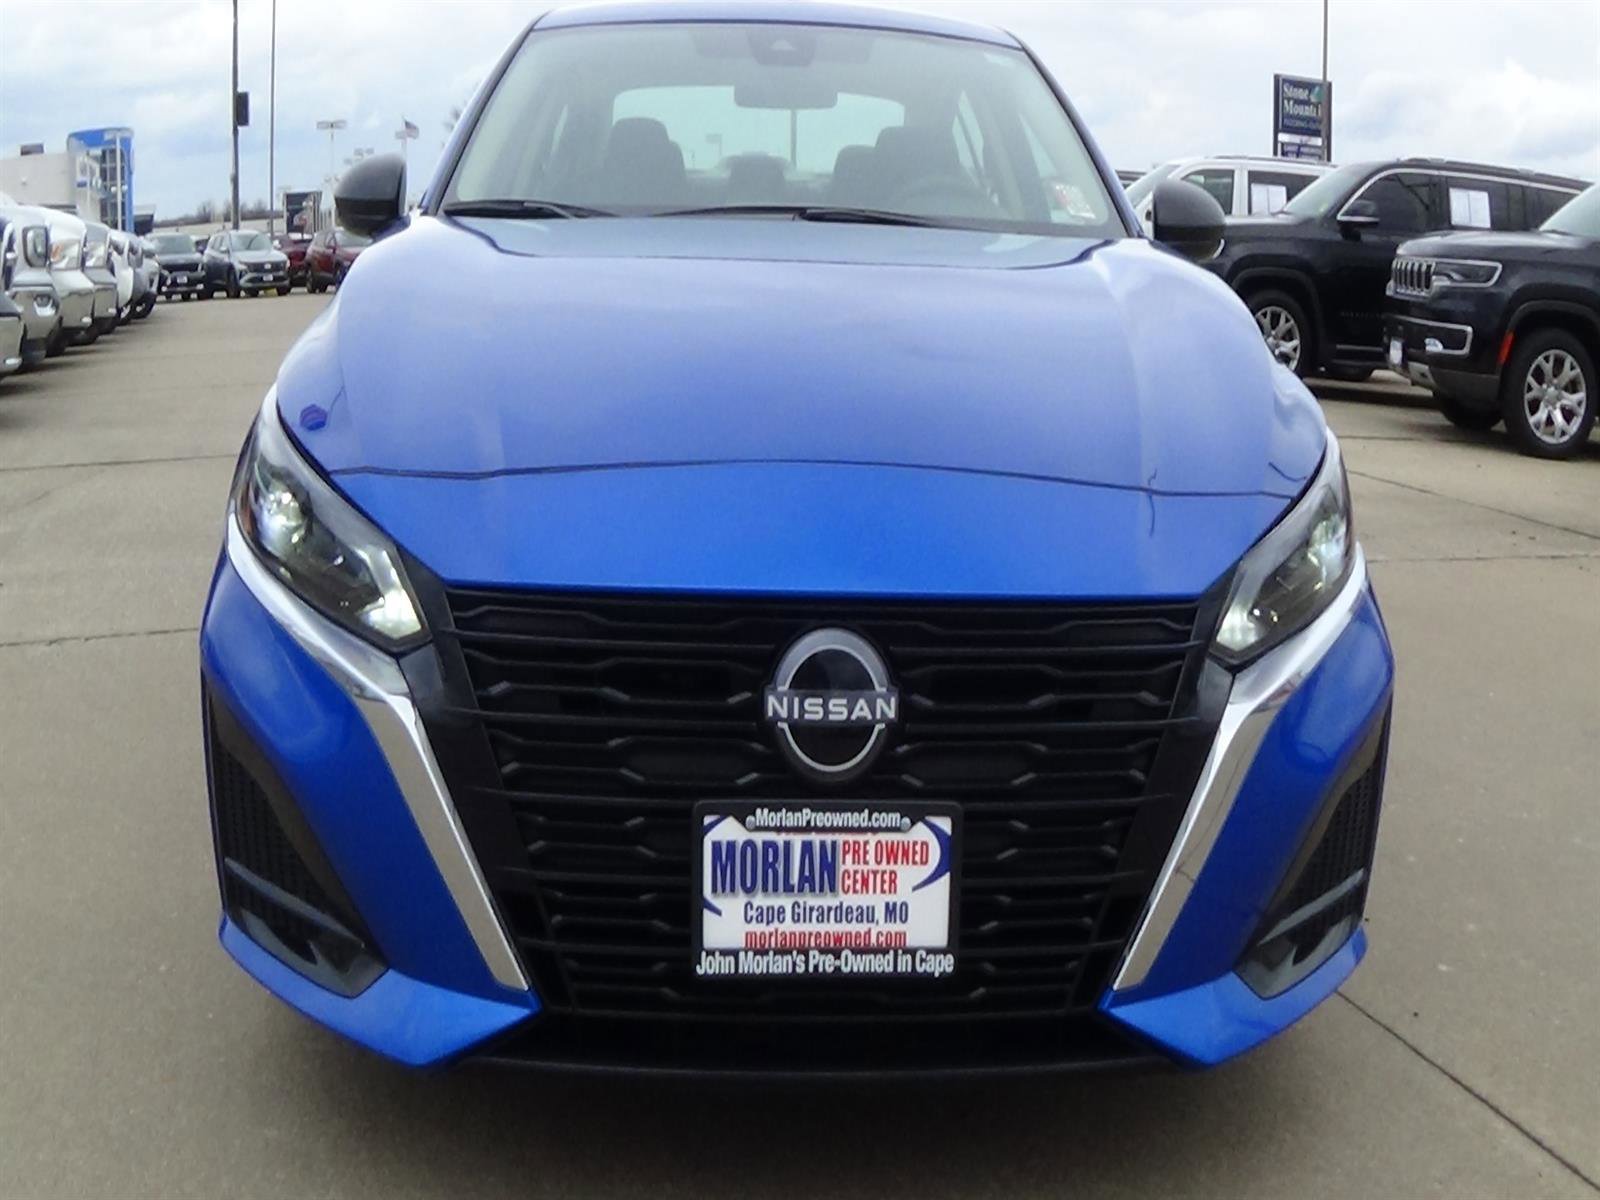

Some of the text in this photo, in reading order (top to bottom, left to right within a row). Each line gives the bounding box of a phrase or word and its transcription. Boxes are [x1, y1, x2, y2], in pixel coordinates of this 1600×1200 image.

[767, 695, 896, 721] NISSAN
[755, 808, 901, 828] MorlanPreowned.com
[841, 840, 929, 865] PRE OWNED
[711, 840, 838, 894] MORLAN
[841, 869, 897, 894] CENTER
[744, 901, 909, 926] Cape Girardeau, MO
[744, 927, 907, 948] morlanpreowned.com
[696, 950, 954, 977] John Morlan's Pre-Owned in Cape
